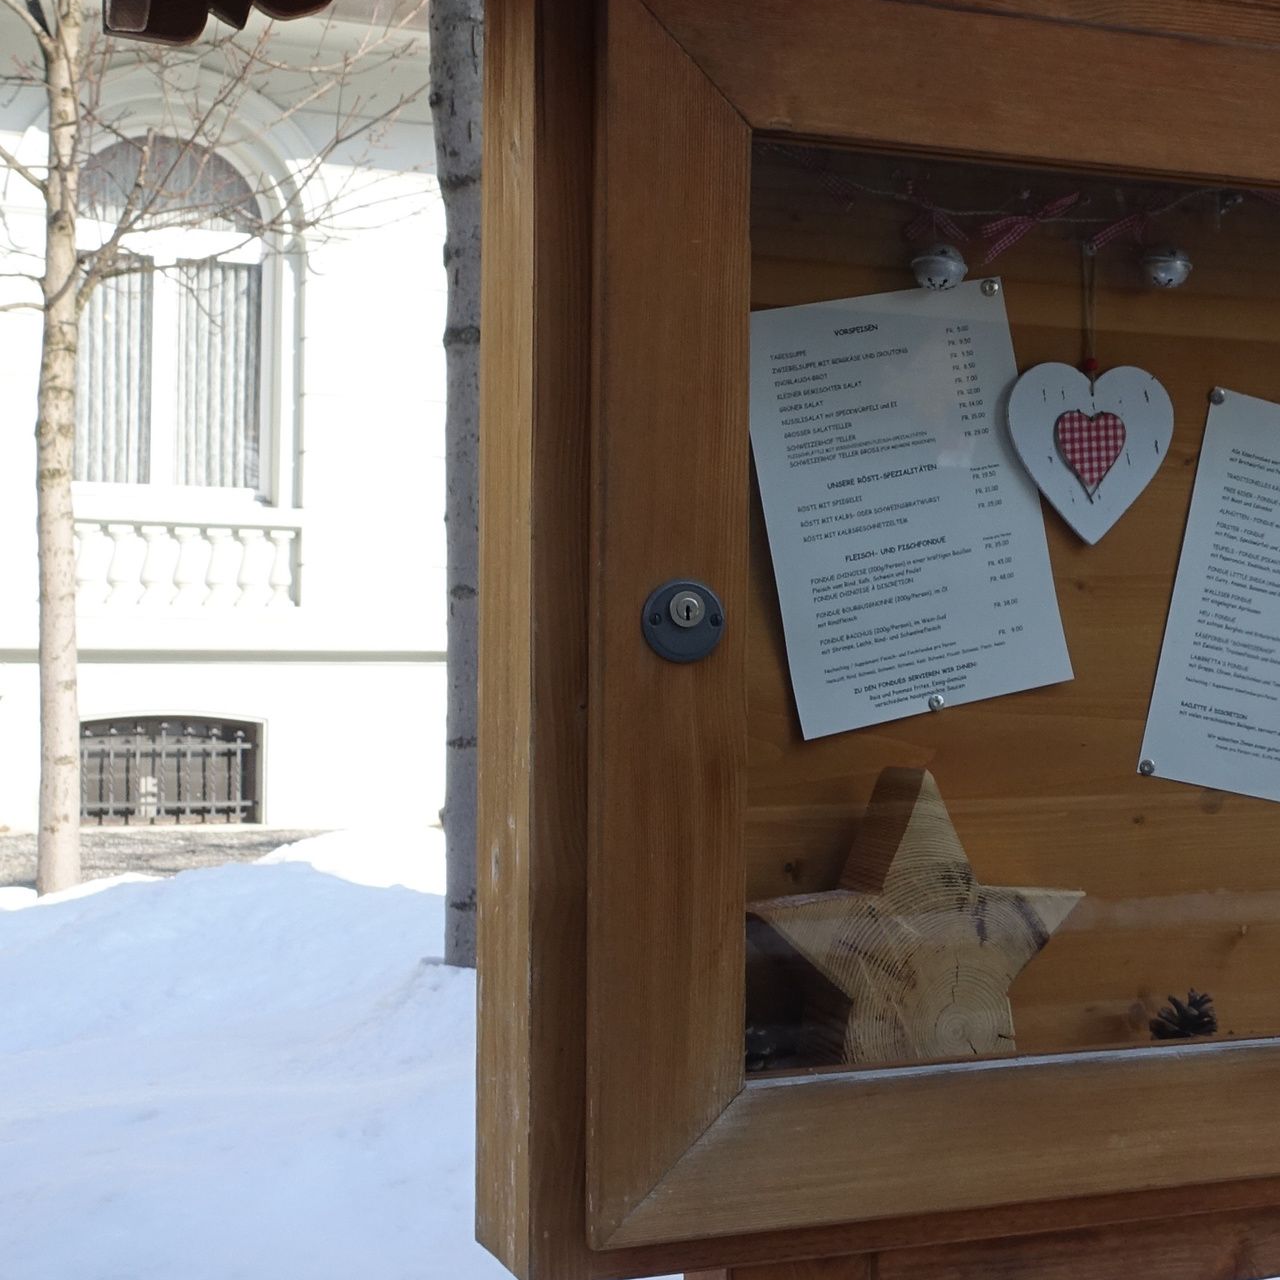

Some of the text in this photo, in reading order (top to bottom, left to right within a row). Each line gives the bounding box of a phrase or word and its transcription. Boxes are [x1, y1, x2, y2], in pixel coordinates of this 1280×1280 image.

[833, 323, 879, 336] VORSPEISEN
[771, 360, 816, 374] ZWIEBELSUPPE
[817, 358, 830, 367] MIT
[861, 351, 875, 361] UND
[776, 380, 862, 400] KLEINER GEMISCHTER SALAT
[803, 399, 824, 409] SALAT
[879, 401, 890, 410] und
[783, 421, 852, 439] GROSSER SALATTELLER
[786, 437, 834, 452] SCHWEIZERHOF
[835, 434, 856, 443] TELLER
[789, 453, 837, 468] SCHWEIZERHOF
[838, 449, 859, 459] TELLER
[859, 446, 880, 456] GROSS
[826, 462, 937, 490] UNSERE RÖSTI-SPEZIALITÄTEN
[799, 517, 820, 528] RÖSTI
[820, 515, 833, 524] MIT
[855, 508, 872, 517] ODER
[872, 495, 940, 514] SCHWEINSBRATWURST
[817, 500, 830, 509] MIT
[831, 495, 862, 507] SPIEGELEI
[802, 532, 823, 543] RÖSTI
[823, 530, 836, 539] MIT
[844, 535, 947, 563] FLEISCH- UND FISCHFONDUE
[809, 573, 835, 586] FONDUE
[835, 567, 867, 581] CHINOISE
[811, 584, 832, 594] Fleisch
[872, 572, 894, 582] Schwein
[894, 569, 905, 578] und
[905, 566, 922, 576] Poulet
[812, 591, 838, 604] FONDUE
[838, 585, 870, 599] CHINOISE
[876, 576, 914, 591] DISCRETION
[815, 607, 841, 620] FONDUE
[826, 615, 858, 627] Rindfleisch
[819, 634, 845, 647] FONDUE
[845, 628, 873, 642] BACCHUS
[852, 685, 863, 694] ZU
[863, 682, 877, 692] DEN
[907, 668, 941, 682] SERVIEREN
[941, 665, 955, 675] WIR
